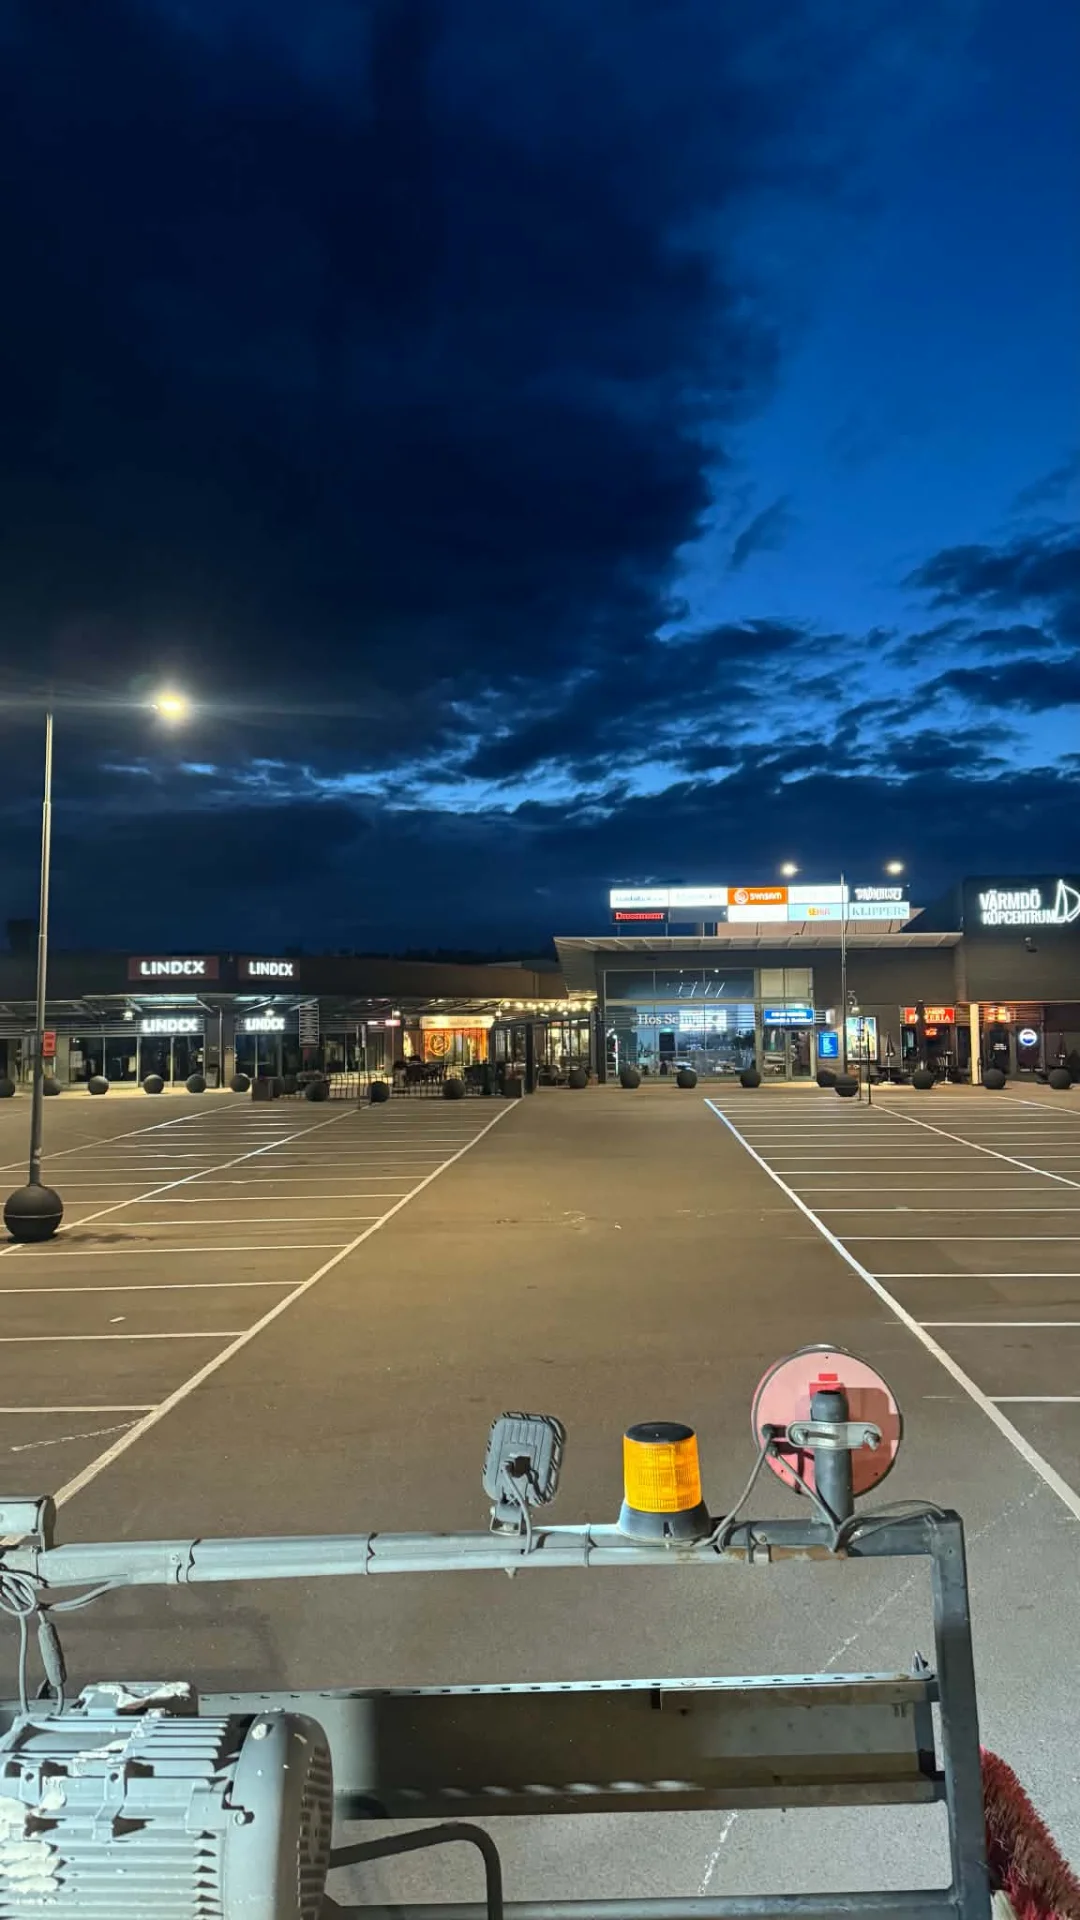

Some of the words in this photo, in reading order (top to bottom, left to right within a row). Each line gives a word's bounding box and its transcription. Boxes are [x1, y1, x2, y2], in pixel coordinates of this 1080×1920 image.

[979, 888, 1041, 910] VÄRMDÖ
[852, 907, 907, 916] KLIPPERS
[982, 908, 1057, 925] KÖPCENTRUM
[140, 961, 205, 975] LINDEX
[249, 962, 293, 976] LINDEX
[142, 1018, 198, 1033] LINDEX
[245, 1018, 285, 1031] LINDEX
